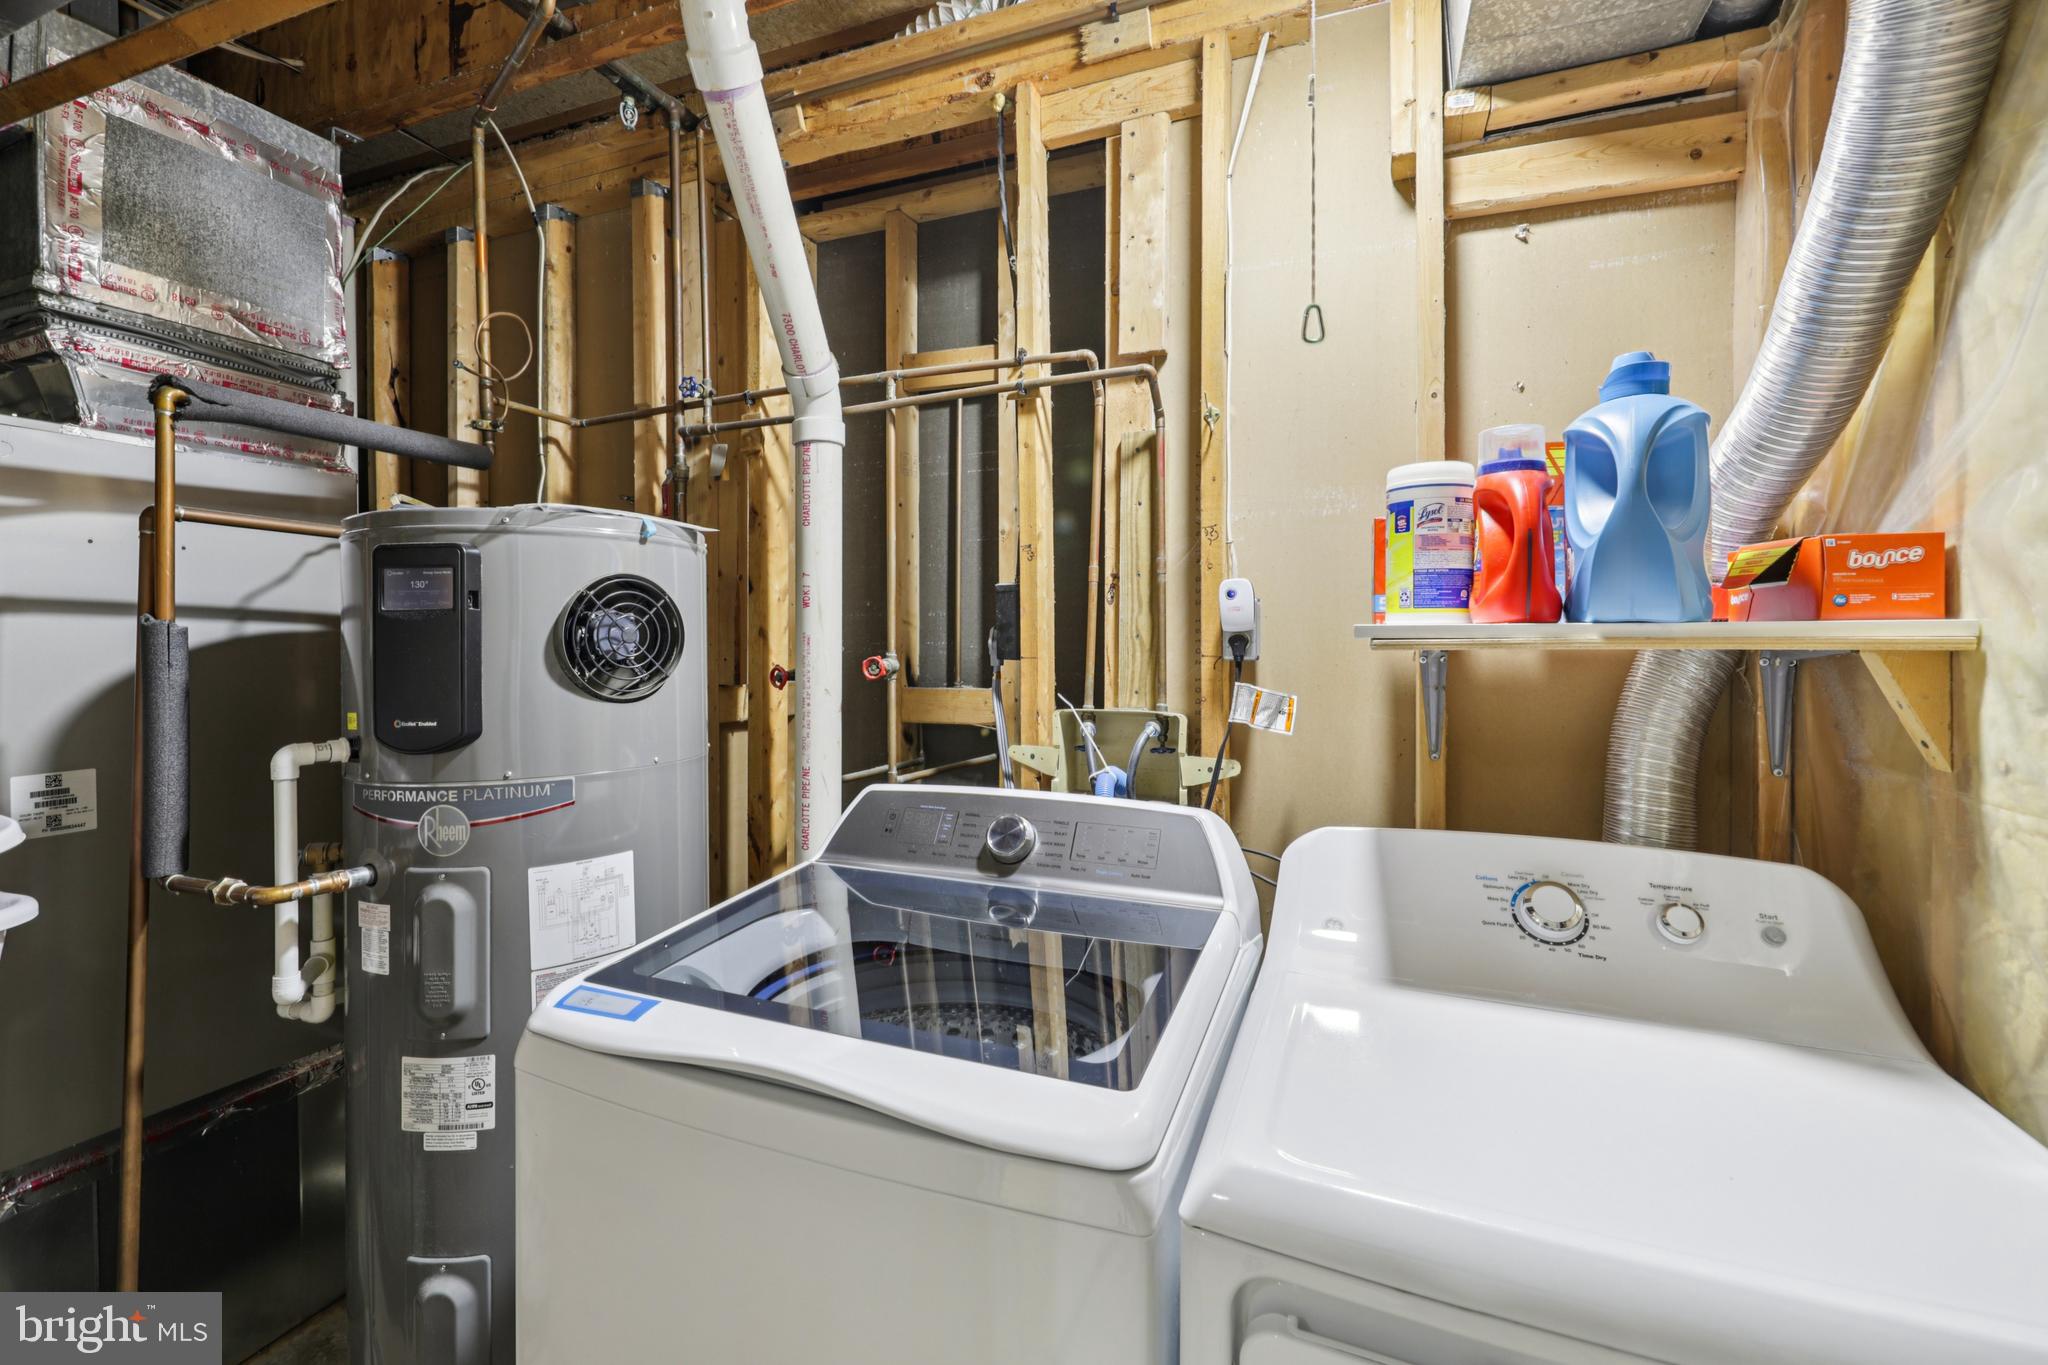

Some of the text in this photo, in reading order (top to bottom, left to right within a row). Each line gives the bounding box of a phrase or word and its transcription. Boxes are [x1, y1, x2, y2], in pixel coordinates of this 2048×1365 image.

[782, 312, 796, 336] 7300
[802, 478, 811, 527] CHARLOTTE
[1419, 503, 1444, 521] Lysol
[1848, 546, 1925, 569] bounce
[410, 580, 429, 589] 130°
[362, 784, 550, 803] PERFORMANCE PLATINUM
[424, 807, 466, 849] Rheem
[802, 803, 811, 851] CHARLOTTE
